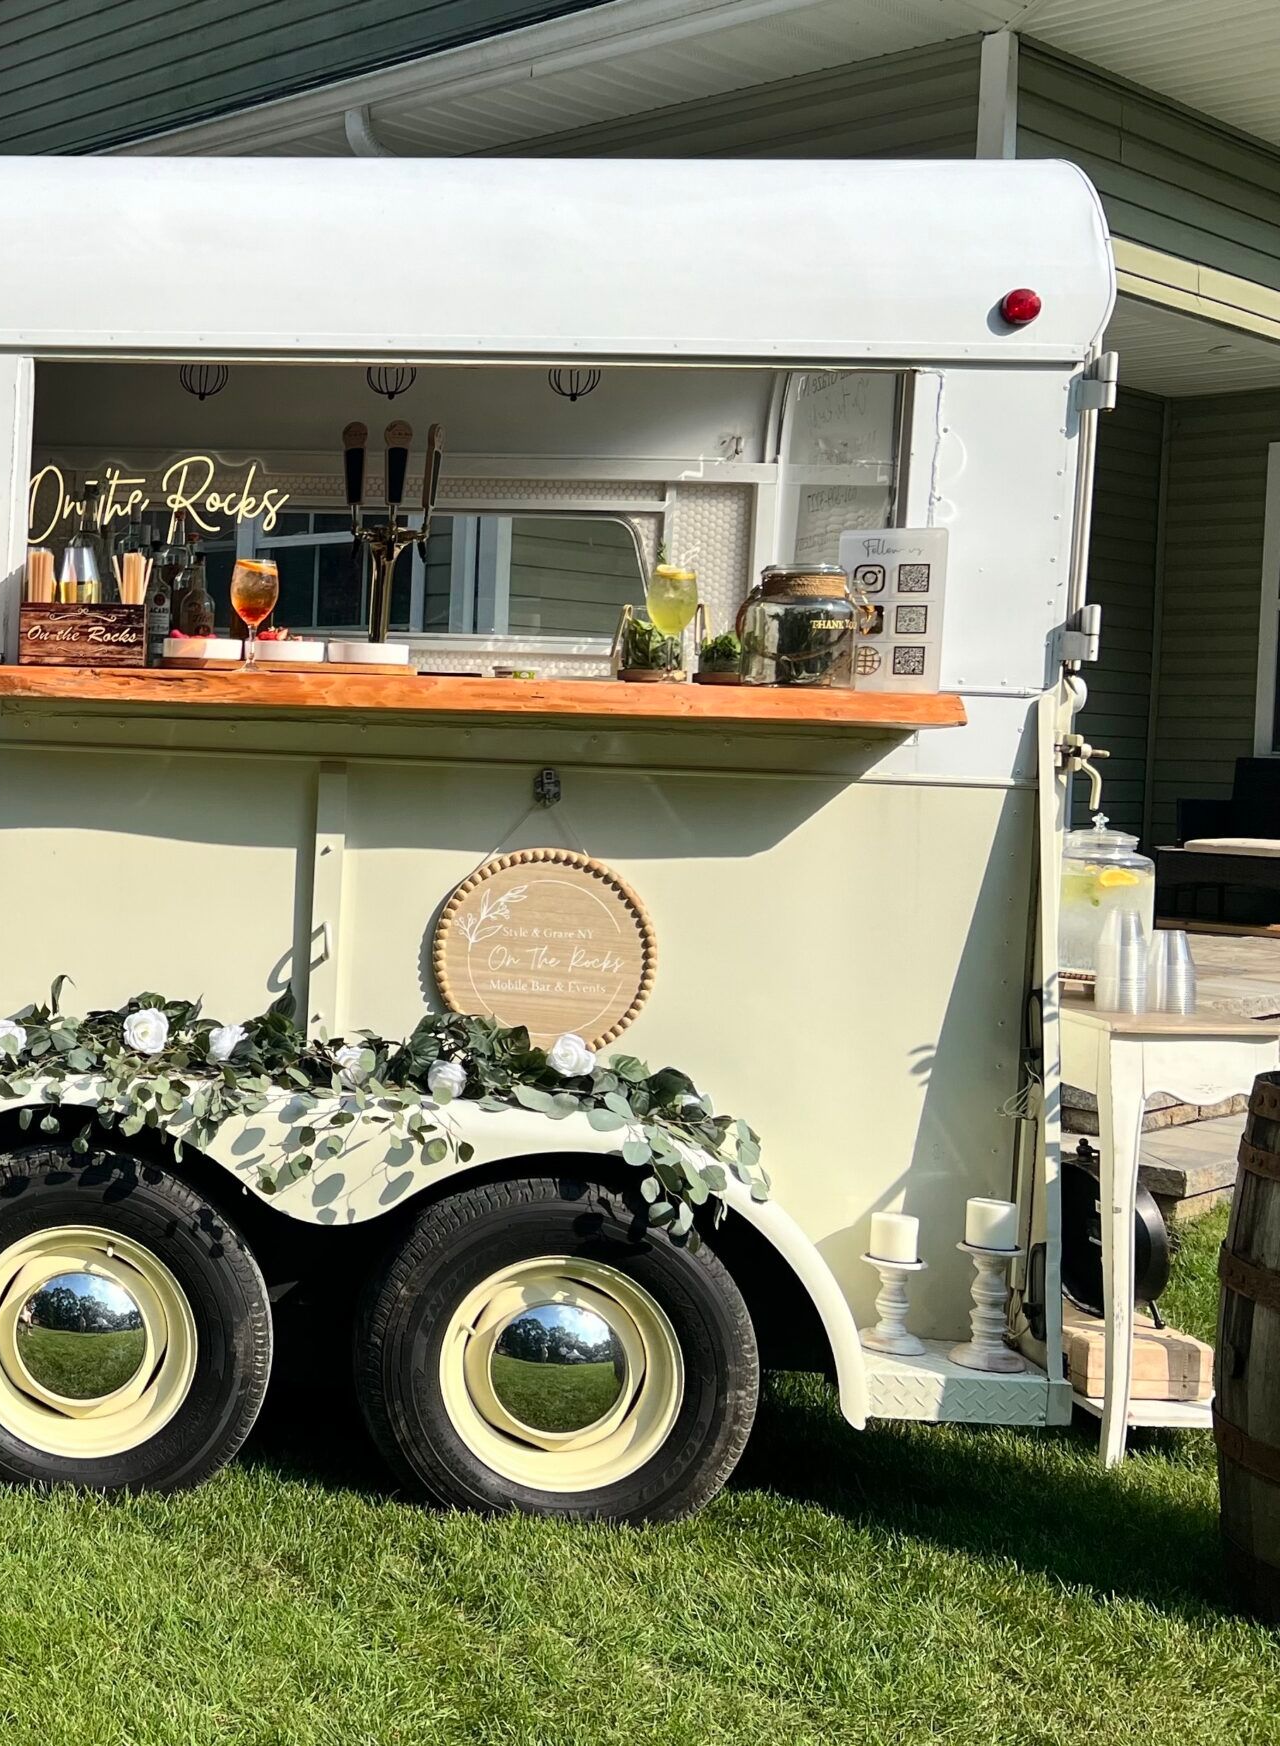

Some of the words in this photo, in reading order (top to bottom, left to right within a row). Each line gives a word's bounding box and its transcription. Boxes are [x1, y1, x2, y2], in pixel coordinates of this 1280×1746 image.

[27, 465, 86, 545] On
[162, 455, 290, 545] Rocks
[862, 538, 903, 557] Follow
[810, 619, 845, 629] THANK
[26, 625, 50, 641] On
[55, 626, 80, 641] the
[86, 626, 138, 643] Rocks
[502, 926, 529, 939] Style
[531, 928, 540, 937] &
[578, 929, 594, 939] NY
[488, 944, 521, 971] On
[526, 944, 561, 970] The
[567, 945, 625, 973] Rocks
[489, 979, 528, 991] Mobile
[531, 980, 552, 992] Bar
[554, 981, 564, 992] &
[567, 981, 607, 993] Events
